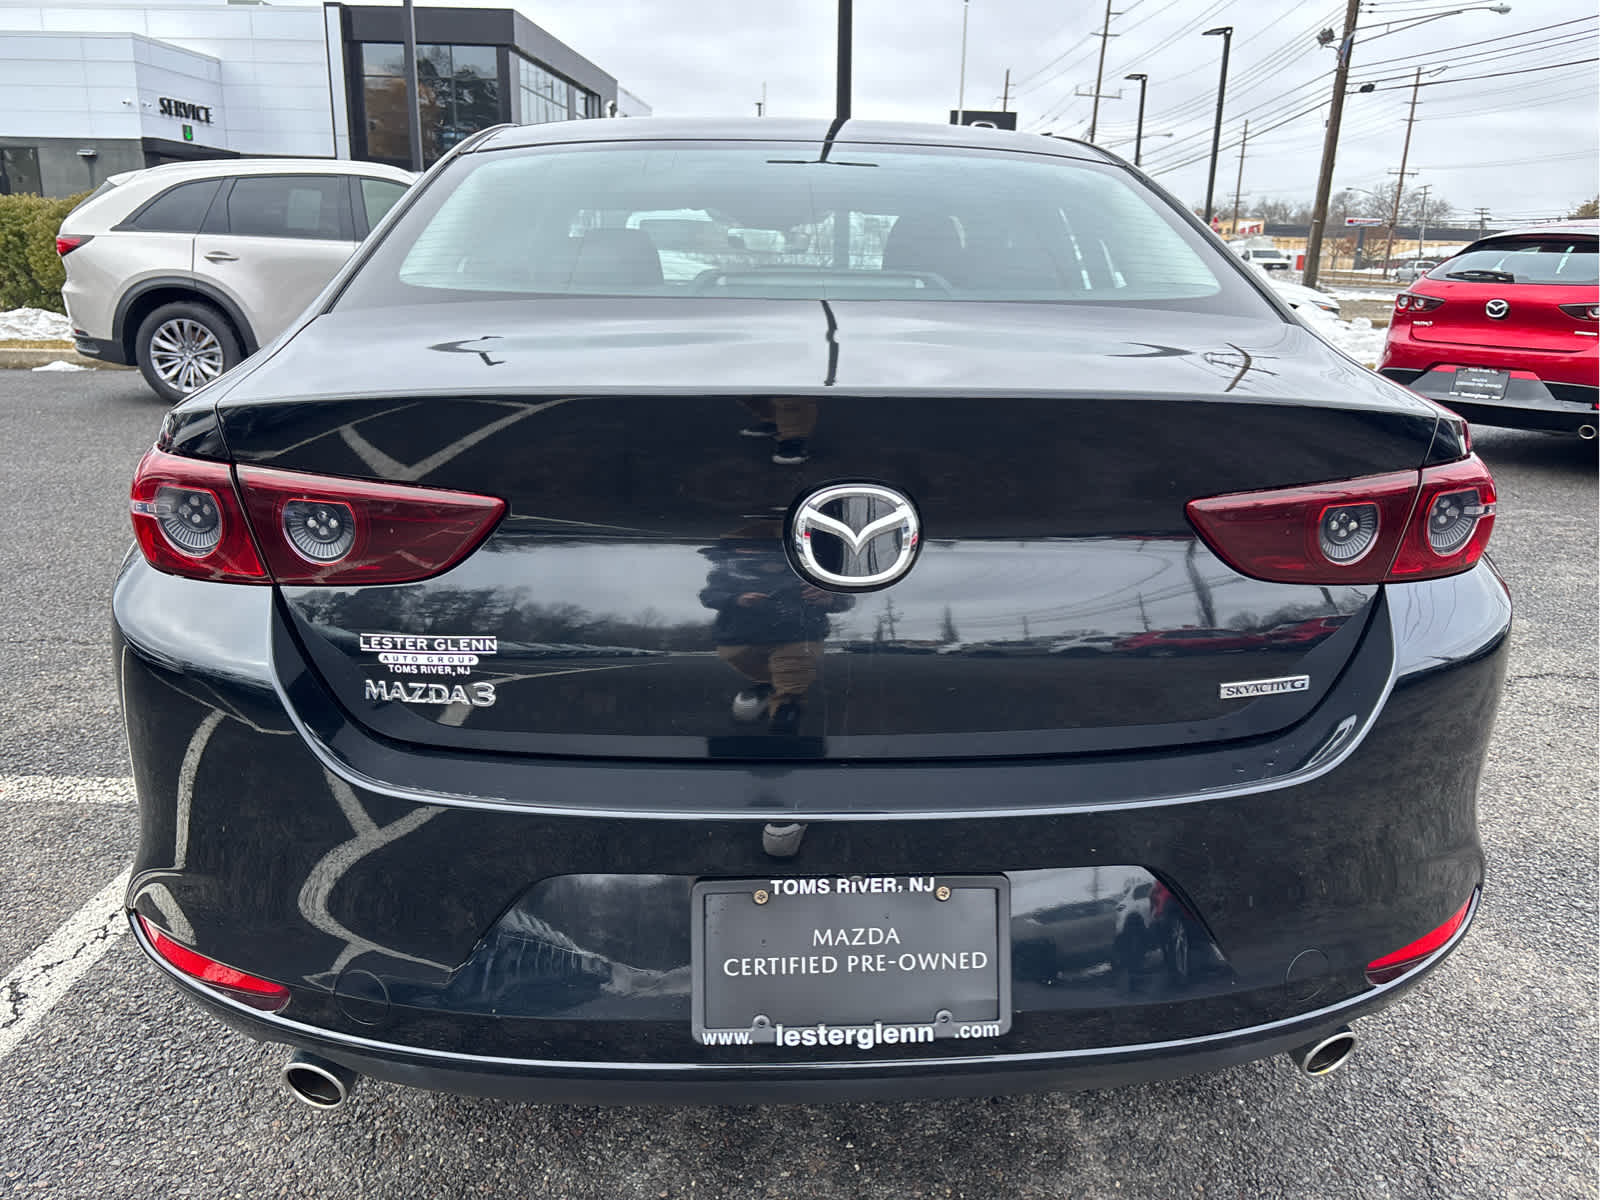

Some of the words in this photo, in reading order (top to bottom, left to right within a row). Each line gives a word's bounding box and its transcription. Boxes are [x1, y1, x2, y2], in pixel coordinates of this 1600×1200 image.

[158, 97, 214, 124] SERVICE
[360, 636, 428, 651] LESTER
[434, 638, 497, 651] GLENN
[382, 654, 418, 663] AUTO
[427, 655, 475, 664] GROUP
[388, 664, 418, 675] TOMS
[364, 679, 497, 707] MAZDA3
[770, 878, 830, 896] TOMS
[836, 877, 903, 894] RIVER,
[909, 876, 935, 892] NJ
[812, 928, 901, 947] MAZDA
[723, 955, 838, 977] CERTIFIED
[847, 951, 989, 973] PRE-OWNED
[702, 1031, 753, 1046] www.
[776, 1022, 935, 1050] lesterglenn
[954, 1022, 1000, 1039] .com
